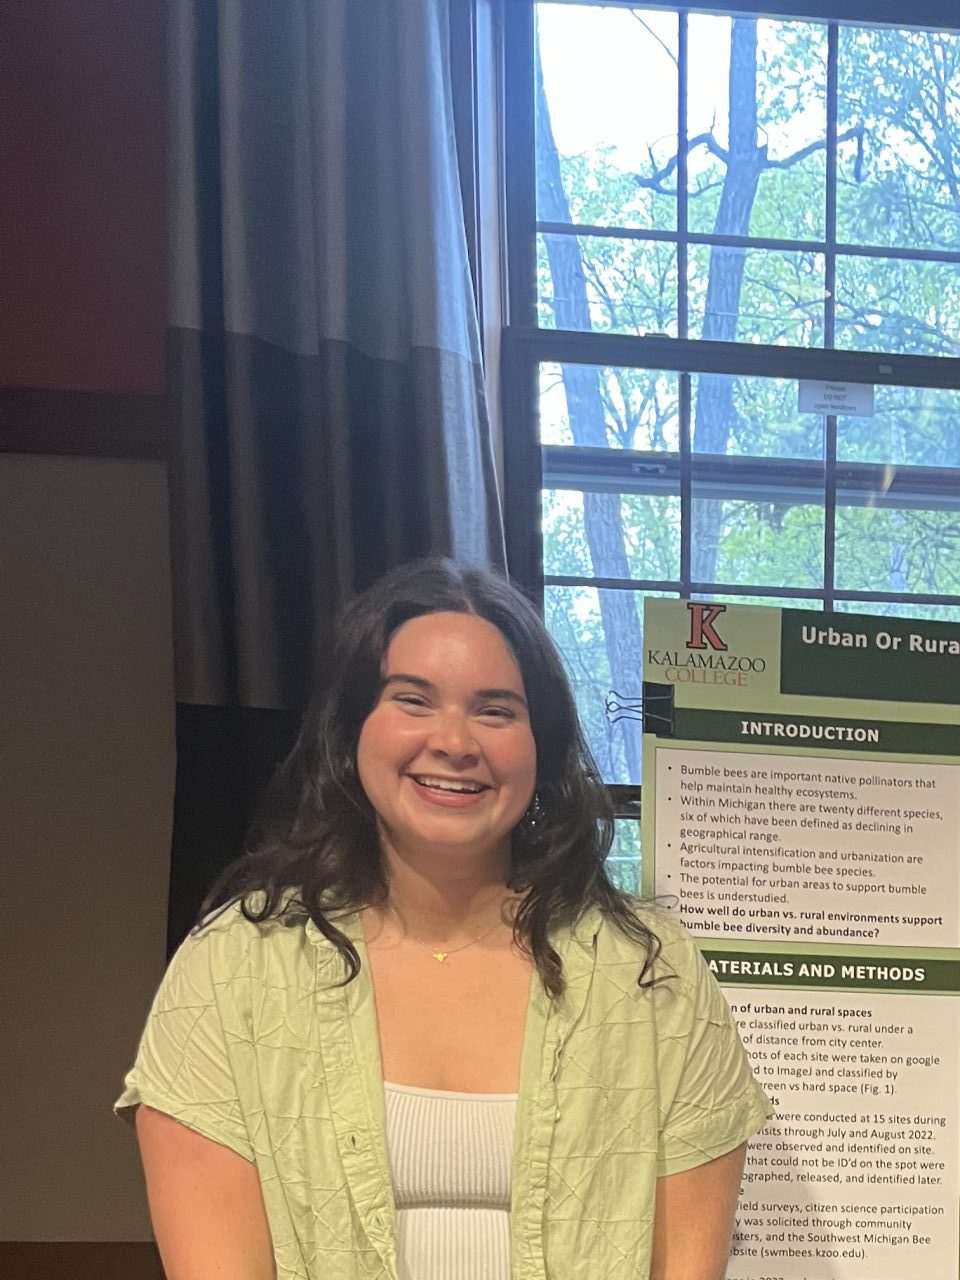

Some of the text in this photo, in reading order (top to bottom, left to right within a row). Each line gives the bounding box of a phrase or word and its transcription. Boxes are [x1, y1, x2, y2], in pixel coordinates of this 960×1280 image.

[686, 602, 728, 651] K
[802, 625, 867, 647] Urban
[875, 631, 901, 650] Or
[648, 650, 766, 672] KALAMAZOO
[665, 667, 748, 687] COLLEGE
[741, 720, 878, 742] INTRODUCTION
[680, 764, 936, 788] Bumble bees are important native pollinators that
[680, 779, 857, 800] help maintain healthy ecosystems.
[680, 795, 943, 820] Within Michigan there are twenty different species,
[679, 903, 942, 926] How well do urban vs. rural environments support
[723, 921, 743, 932] bee
[745, 922, 791, 936] diversity
[793, 925, 813, 935] and
[816, 925, 879, 938] abundance?
[707, 959, 925, 981] ATERIALS AND METHODS
[742, 1033, 883, 1049] of distance from city center.
[784, 1126, 824, 1139] through
[827, 1127, 846, 1140] July
[848, 1128, 868, 1138] and
[870, 1129, 905, 1141] August
[908, 1129, 936, 1140] 2022.
